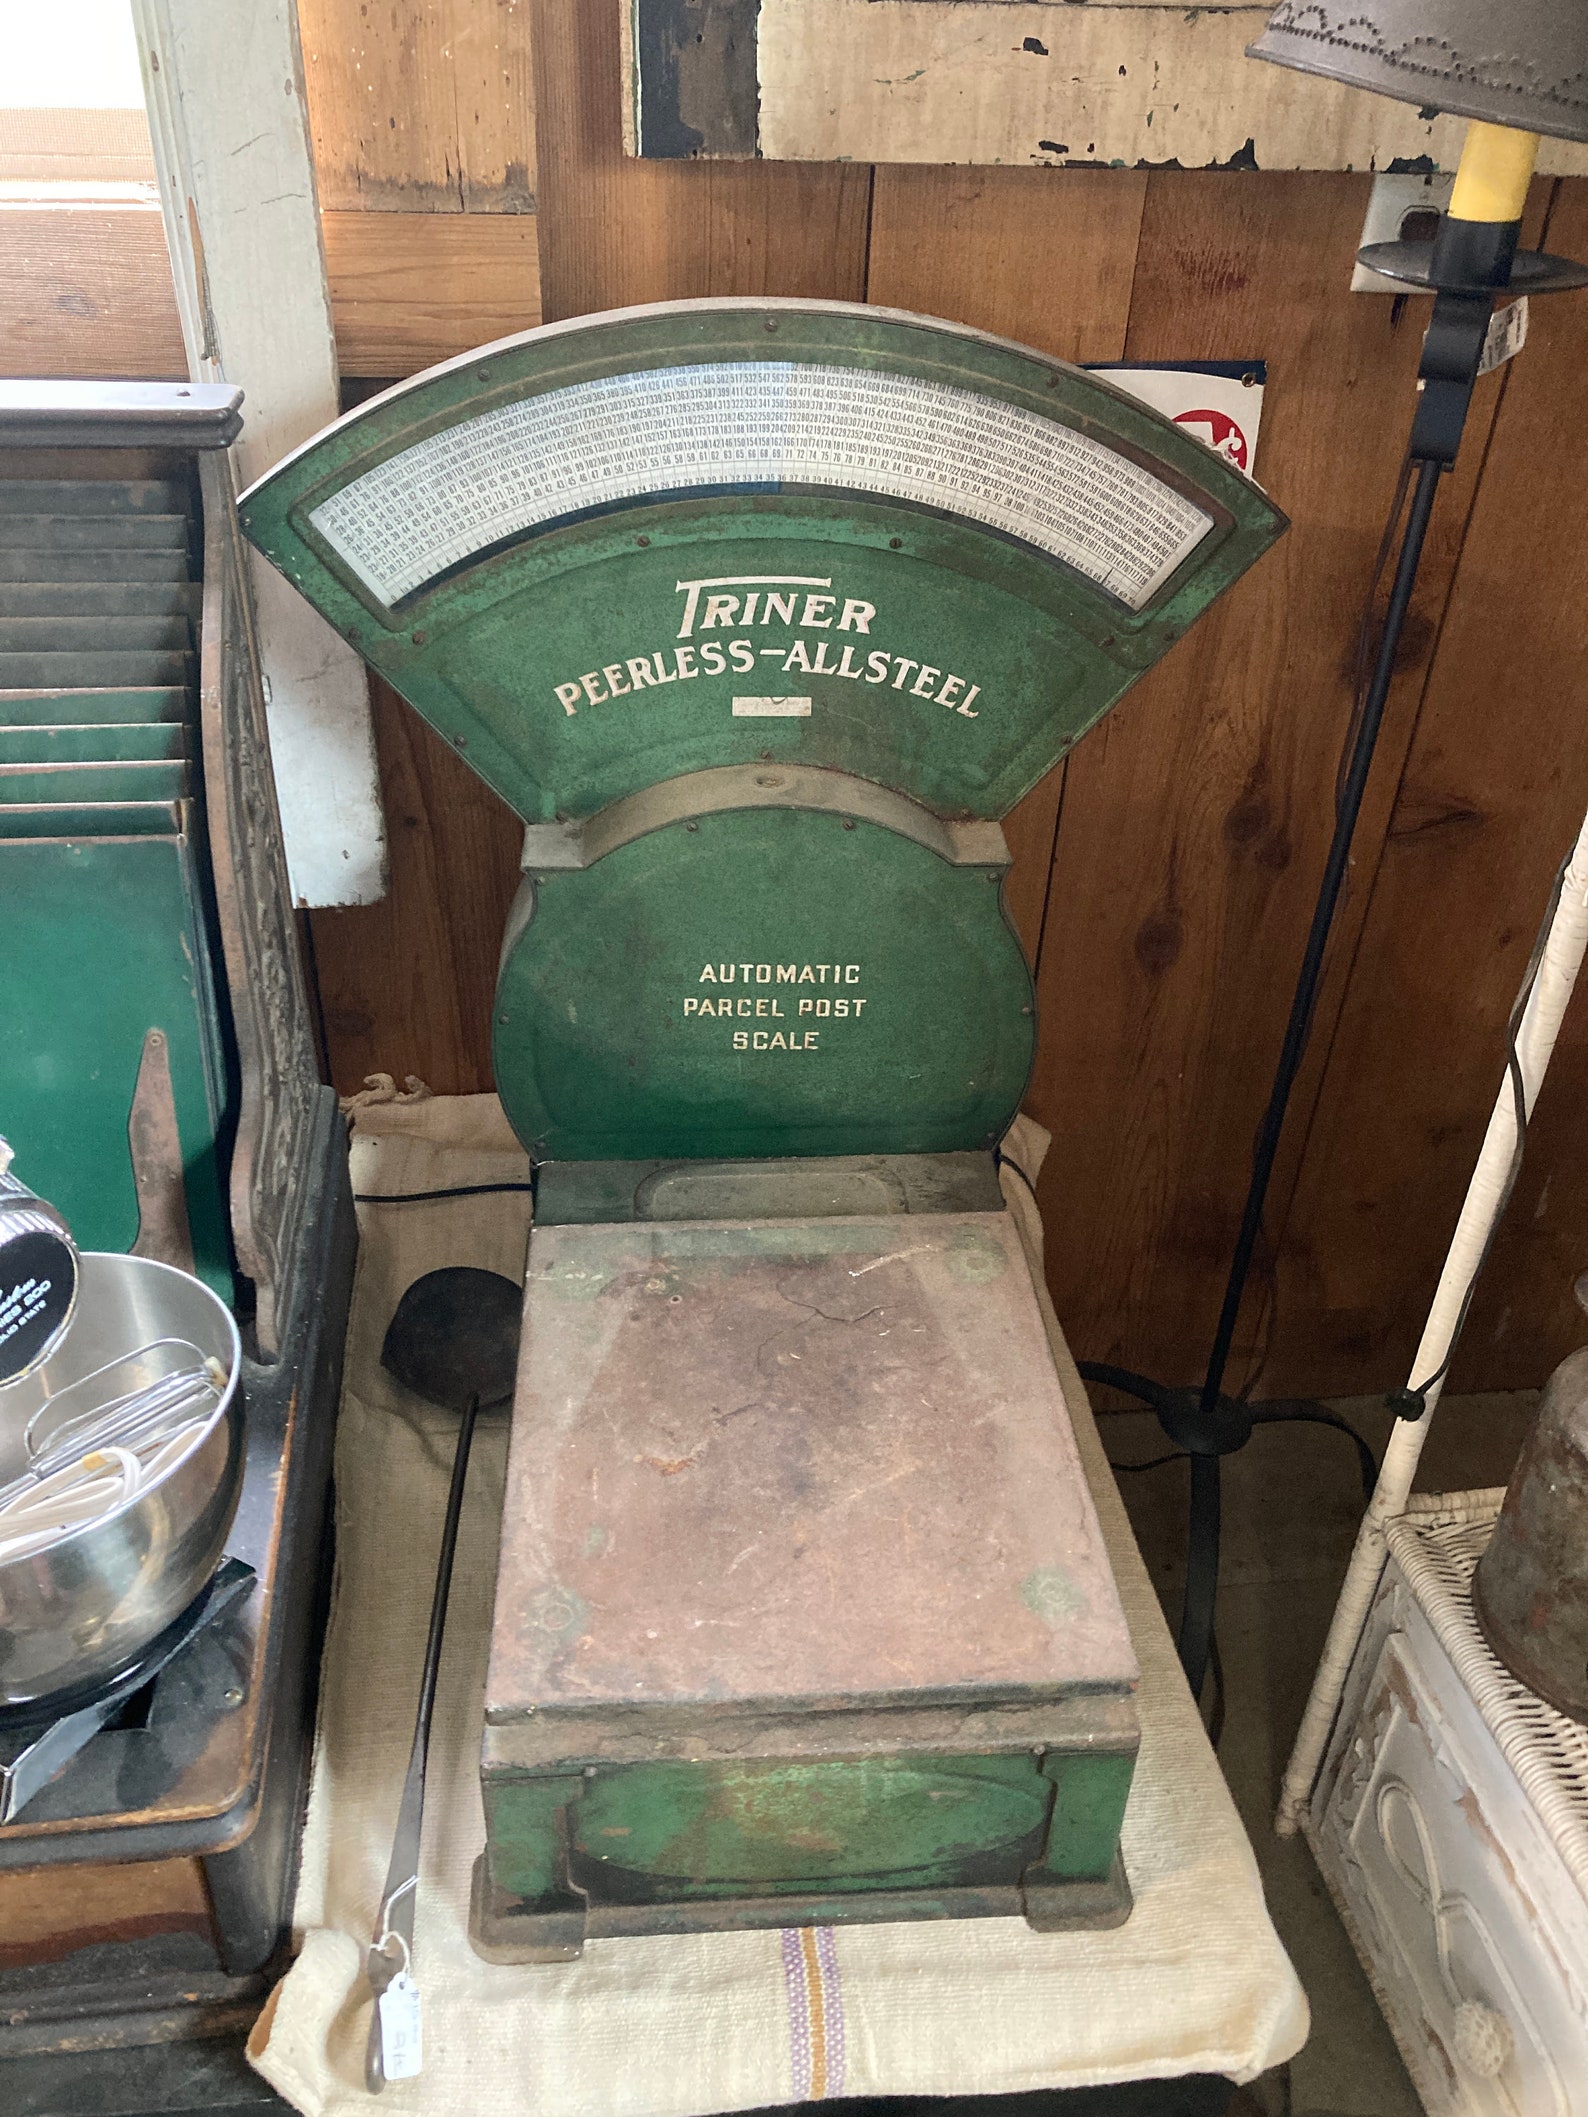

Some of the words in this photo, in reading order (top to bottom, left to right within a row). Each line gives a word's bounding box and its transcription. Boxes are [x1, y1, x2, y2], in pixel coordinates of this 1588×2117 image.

[675, 576, 876, 638] TRINER
[699, 964, 860, 984] AUTOMATIC
[684, 998, 785, 1018] PARCEL
[798, 999, 867, 1018] POST
[732, 1031, 820, 1050] SCALE
